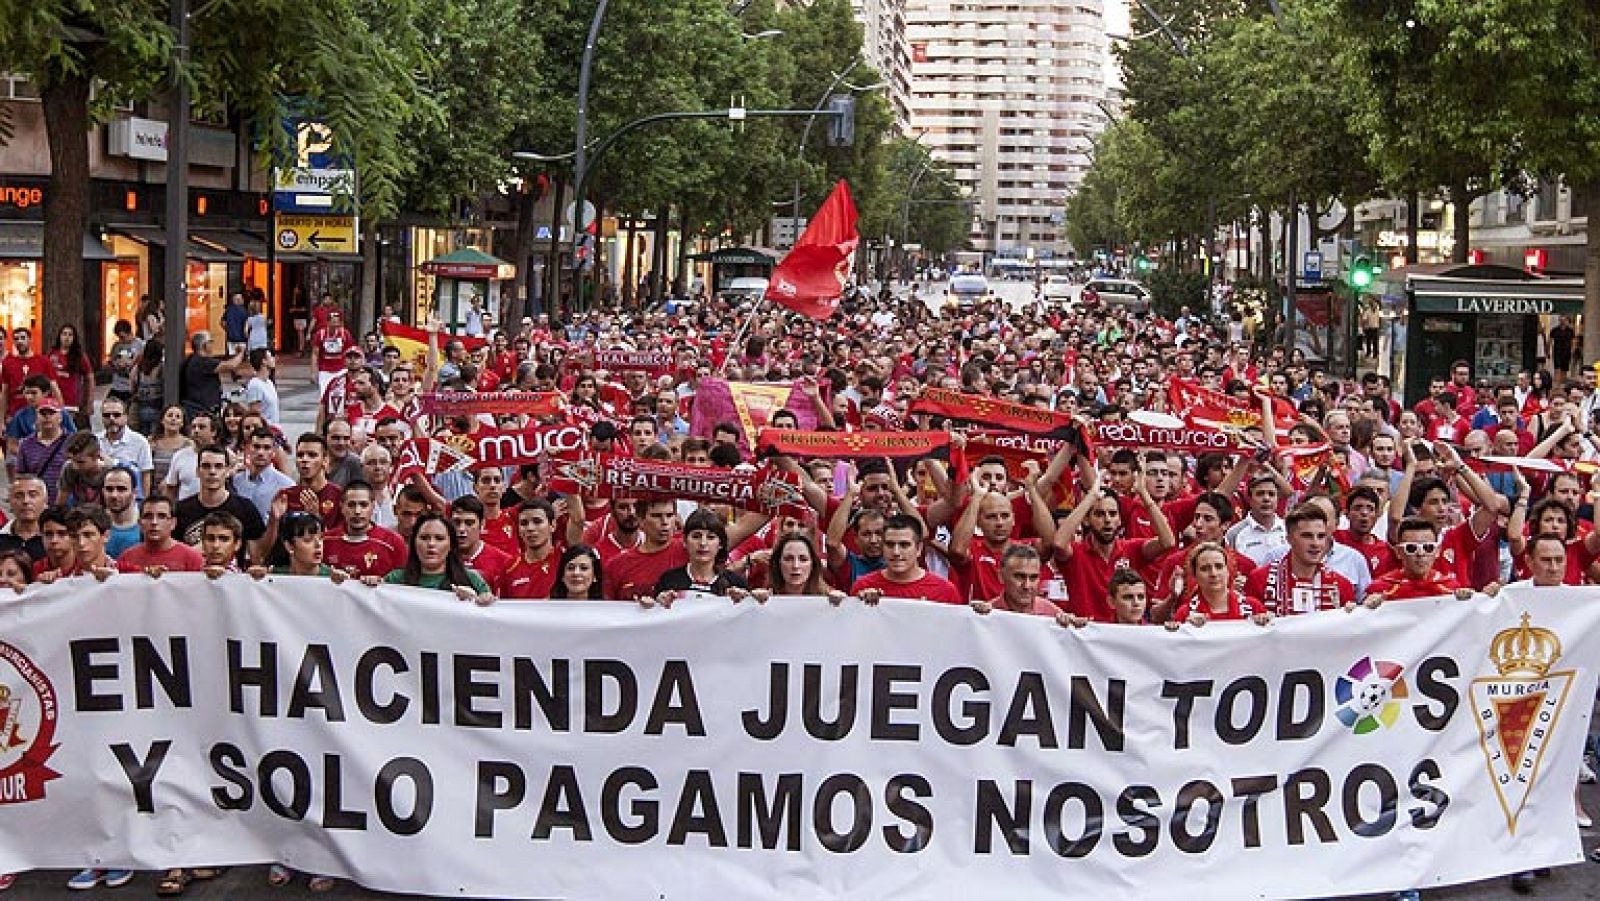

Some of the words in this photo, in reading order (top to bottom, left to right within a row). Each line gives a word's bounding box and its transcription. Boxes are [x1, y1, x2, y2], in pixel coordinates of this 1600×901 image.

[1457, 297, 1480, 312] LA
[1480, 298, 1553, 314] VERDAD
[1098, 423, 1145, 443] real
[1149, 428, 1228, 447] murcia
[605, 468, 660, 488] REAL
[670, 476, 754, 499] MURCIA
[69, 636, 192, 711] EN
[227, 638, 706, 736] HACIENDA
[742, 662, 1125, 751] JUEGAN
[1487, 680, 1550, 696] MURCIA
[0, 773, 27, 800] UR
[109, 739, 172, 814] Y
[210, 743, 433, 836] SOLO
[475, 760, 933, 853] PAGAMOS
[975, 759, 1448, 857] NOSOTROS
